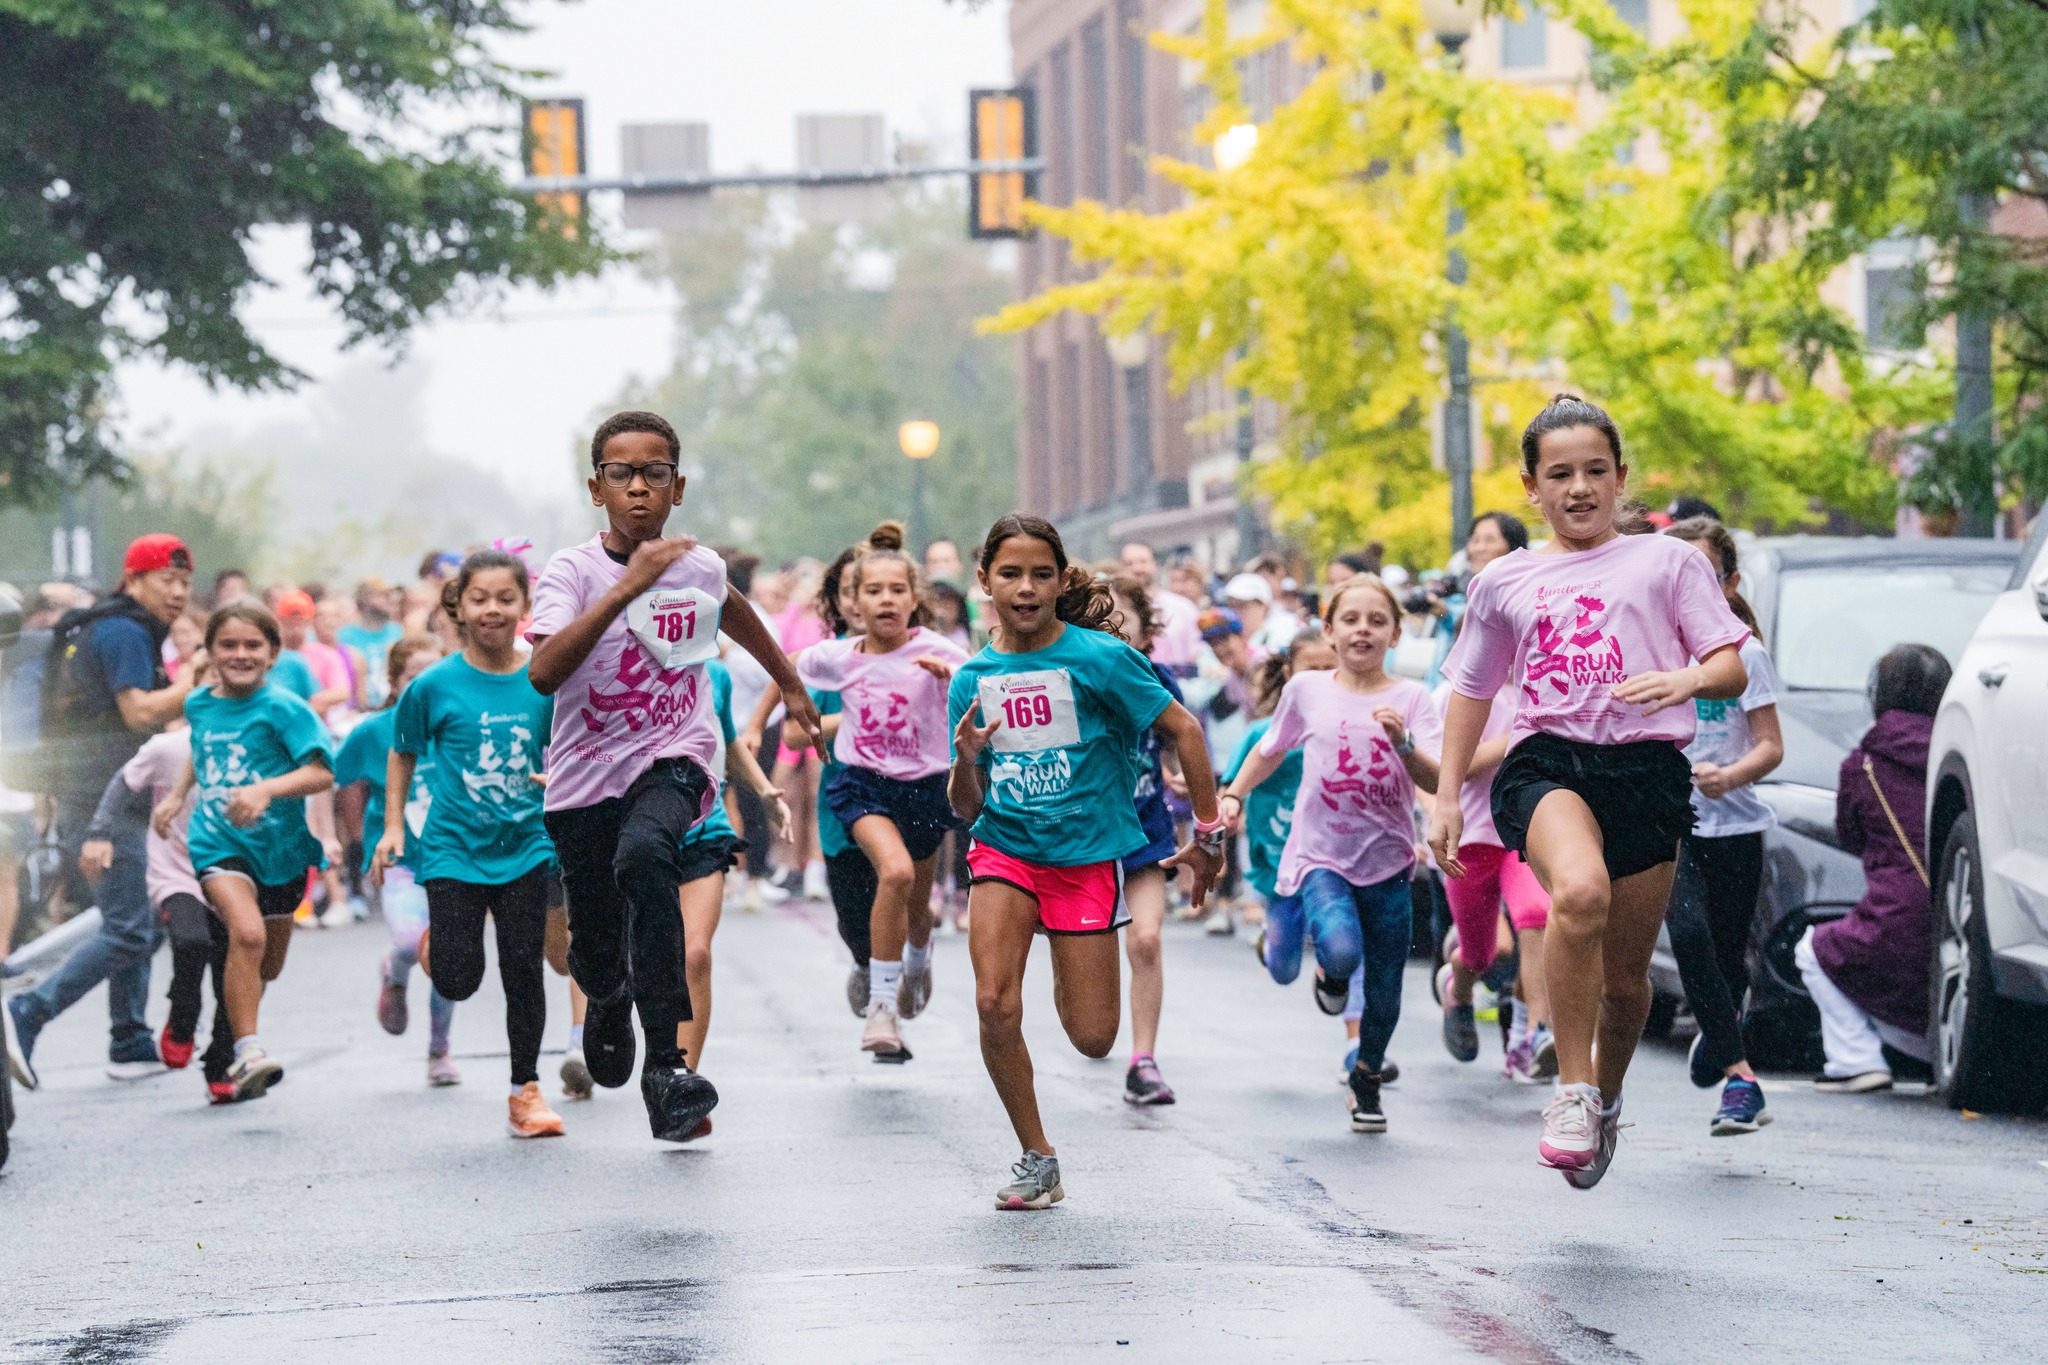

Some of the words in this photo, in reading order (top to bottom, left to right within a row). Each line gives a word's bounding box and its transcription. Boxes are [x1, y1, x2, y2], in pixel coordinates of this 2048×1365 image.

[653, 611, 695, 643] 781
[1572, 653, 1623, 673] RUN
[1573, 671, 1623, 686] WALK
[655, 693, 695, 713] RUN
[1001, 695, 1052, 729] 169
[888, 735, 920, 749] RUN
[1025, 762, 1071, 783] RUN
[1027, 779, 1070, 796] WALK
